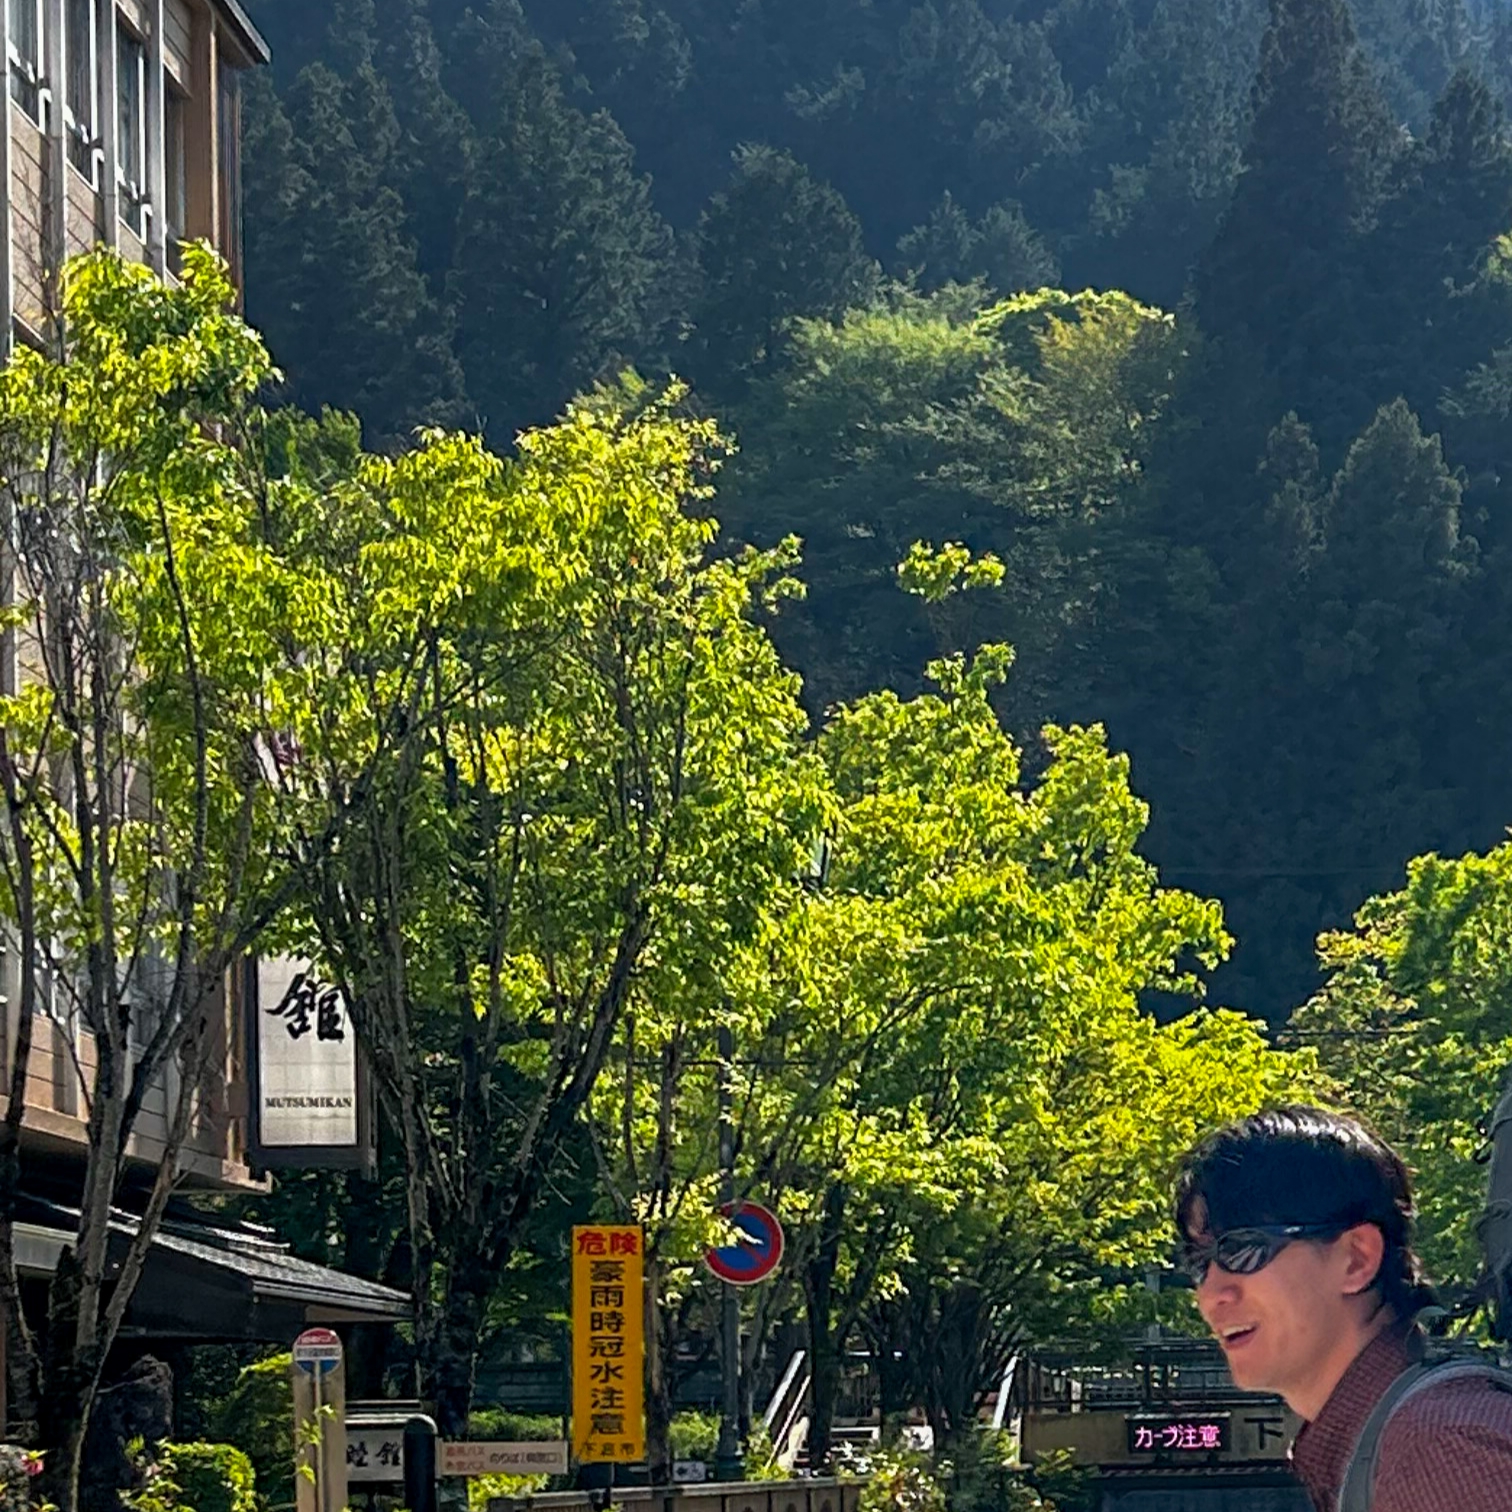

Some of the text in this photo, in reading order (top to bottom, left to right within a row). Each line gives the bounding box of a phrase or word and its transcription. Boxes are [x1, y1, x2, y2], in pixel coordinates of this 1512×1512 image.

[265, 1097, 352, 1108] MUTSUMIKAN
[577, 1231, 638, 1255] 危険
[590, 1260, 626, 1435] 豪雨時冠水注意
[1134, 1424, 1221, 1448] カーブ注意
[1244, 1417, 1283, 1450] 下
